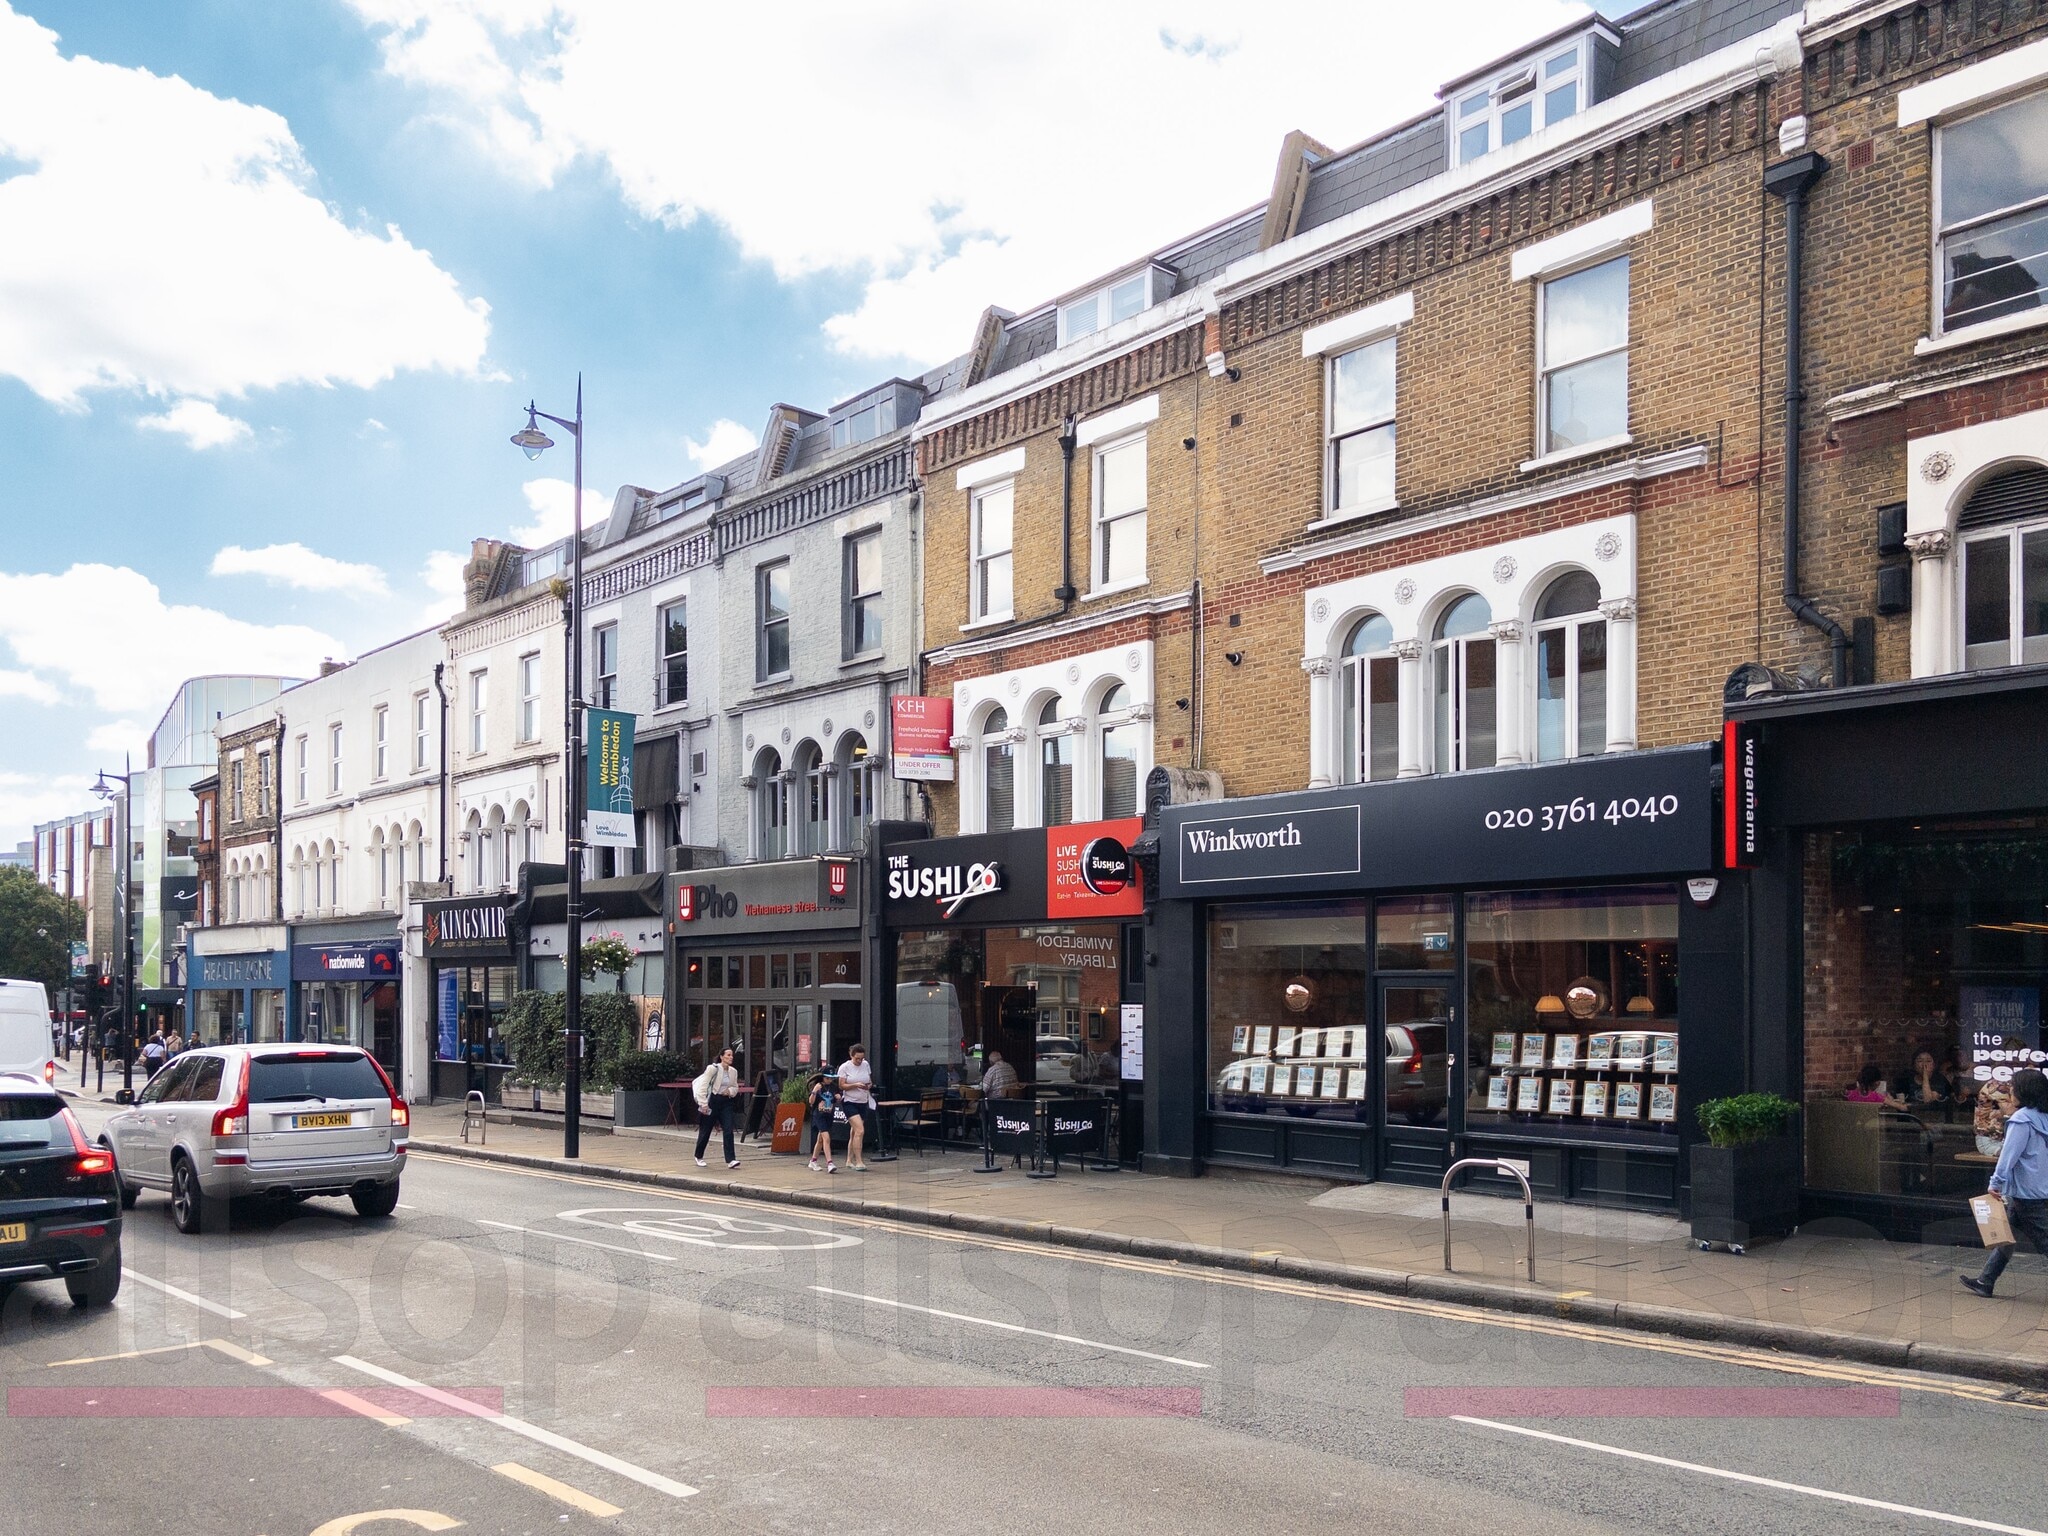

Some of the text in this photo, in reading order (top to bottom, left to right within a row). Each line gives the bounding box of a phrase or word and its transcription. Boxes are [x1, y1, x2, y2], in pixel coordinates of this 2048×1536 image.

[897, 700, 925, 712] KFH
[600, 719, 610, 785] Welcome to
[610, 721, 621, 786] Wimbledon
[1744, 738, 1755, 853] wagamama
[1484, 794, 1679, 831] 020 3761 4040
[596, 830, 628, 838] Wimbledon
[1187, 822, 1302, 853] Winkworth
[1056, 845, 1078, 857] LIVE
[888, 855, 909, 869] THE
[1056, 859, 1081, 871] SUSH
[1092, 860, 1115, 869] SUSHI
[888, 865, 961, 899] SUSHI
[1056, 874, 1083, 886] KITCH
[694, 884, 738, 919] Pho
[829, 895, 845, 905] Pho
[744, 903, 792, 916] Vietnamese
[793, 900, 819, 912] stree
[441, 906, 506, 940] KINGSMIR
[328, 953, 366, 970] nationwide
[203, 959, 272, 982] HEALTH ZONE
[835, 964, 847, 975] 40
[1973, 1031, 2002, 1046] the
[1973, 1048, 2048, 1063] perfe
[301, 1114, 348, 1126] BV13 XHN
[997, 1120, 1020, 1129] SUSHI
[1054, 1120, 1080, 1131] SUSHI
